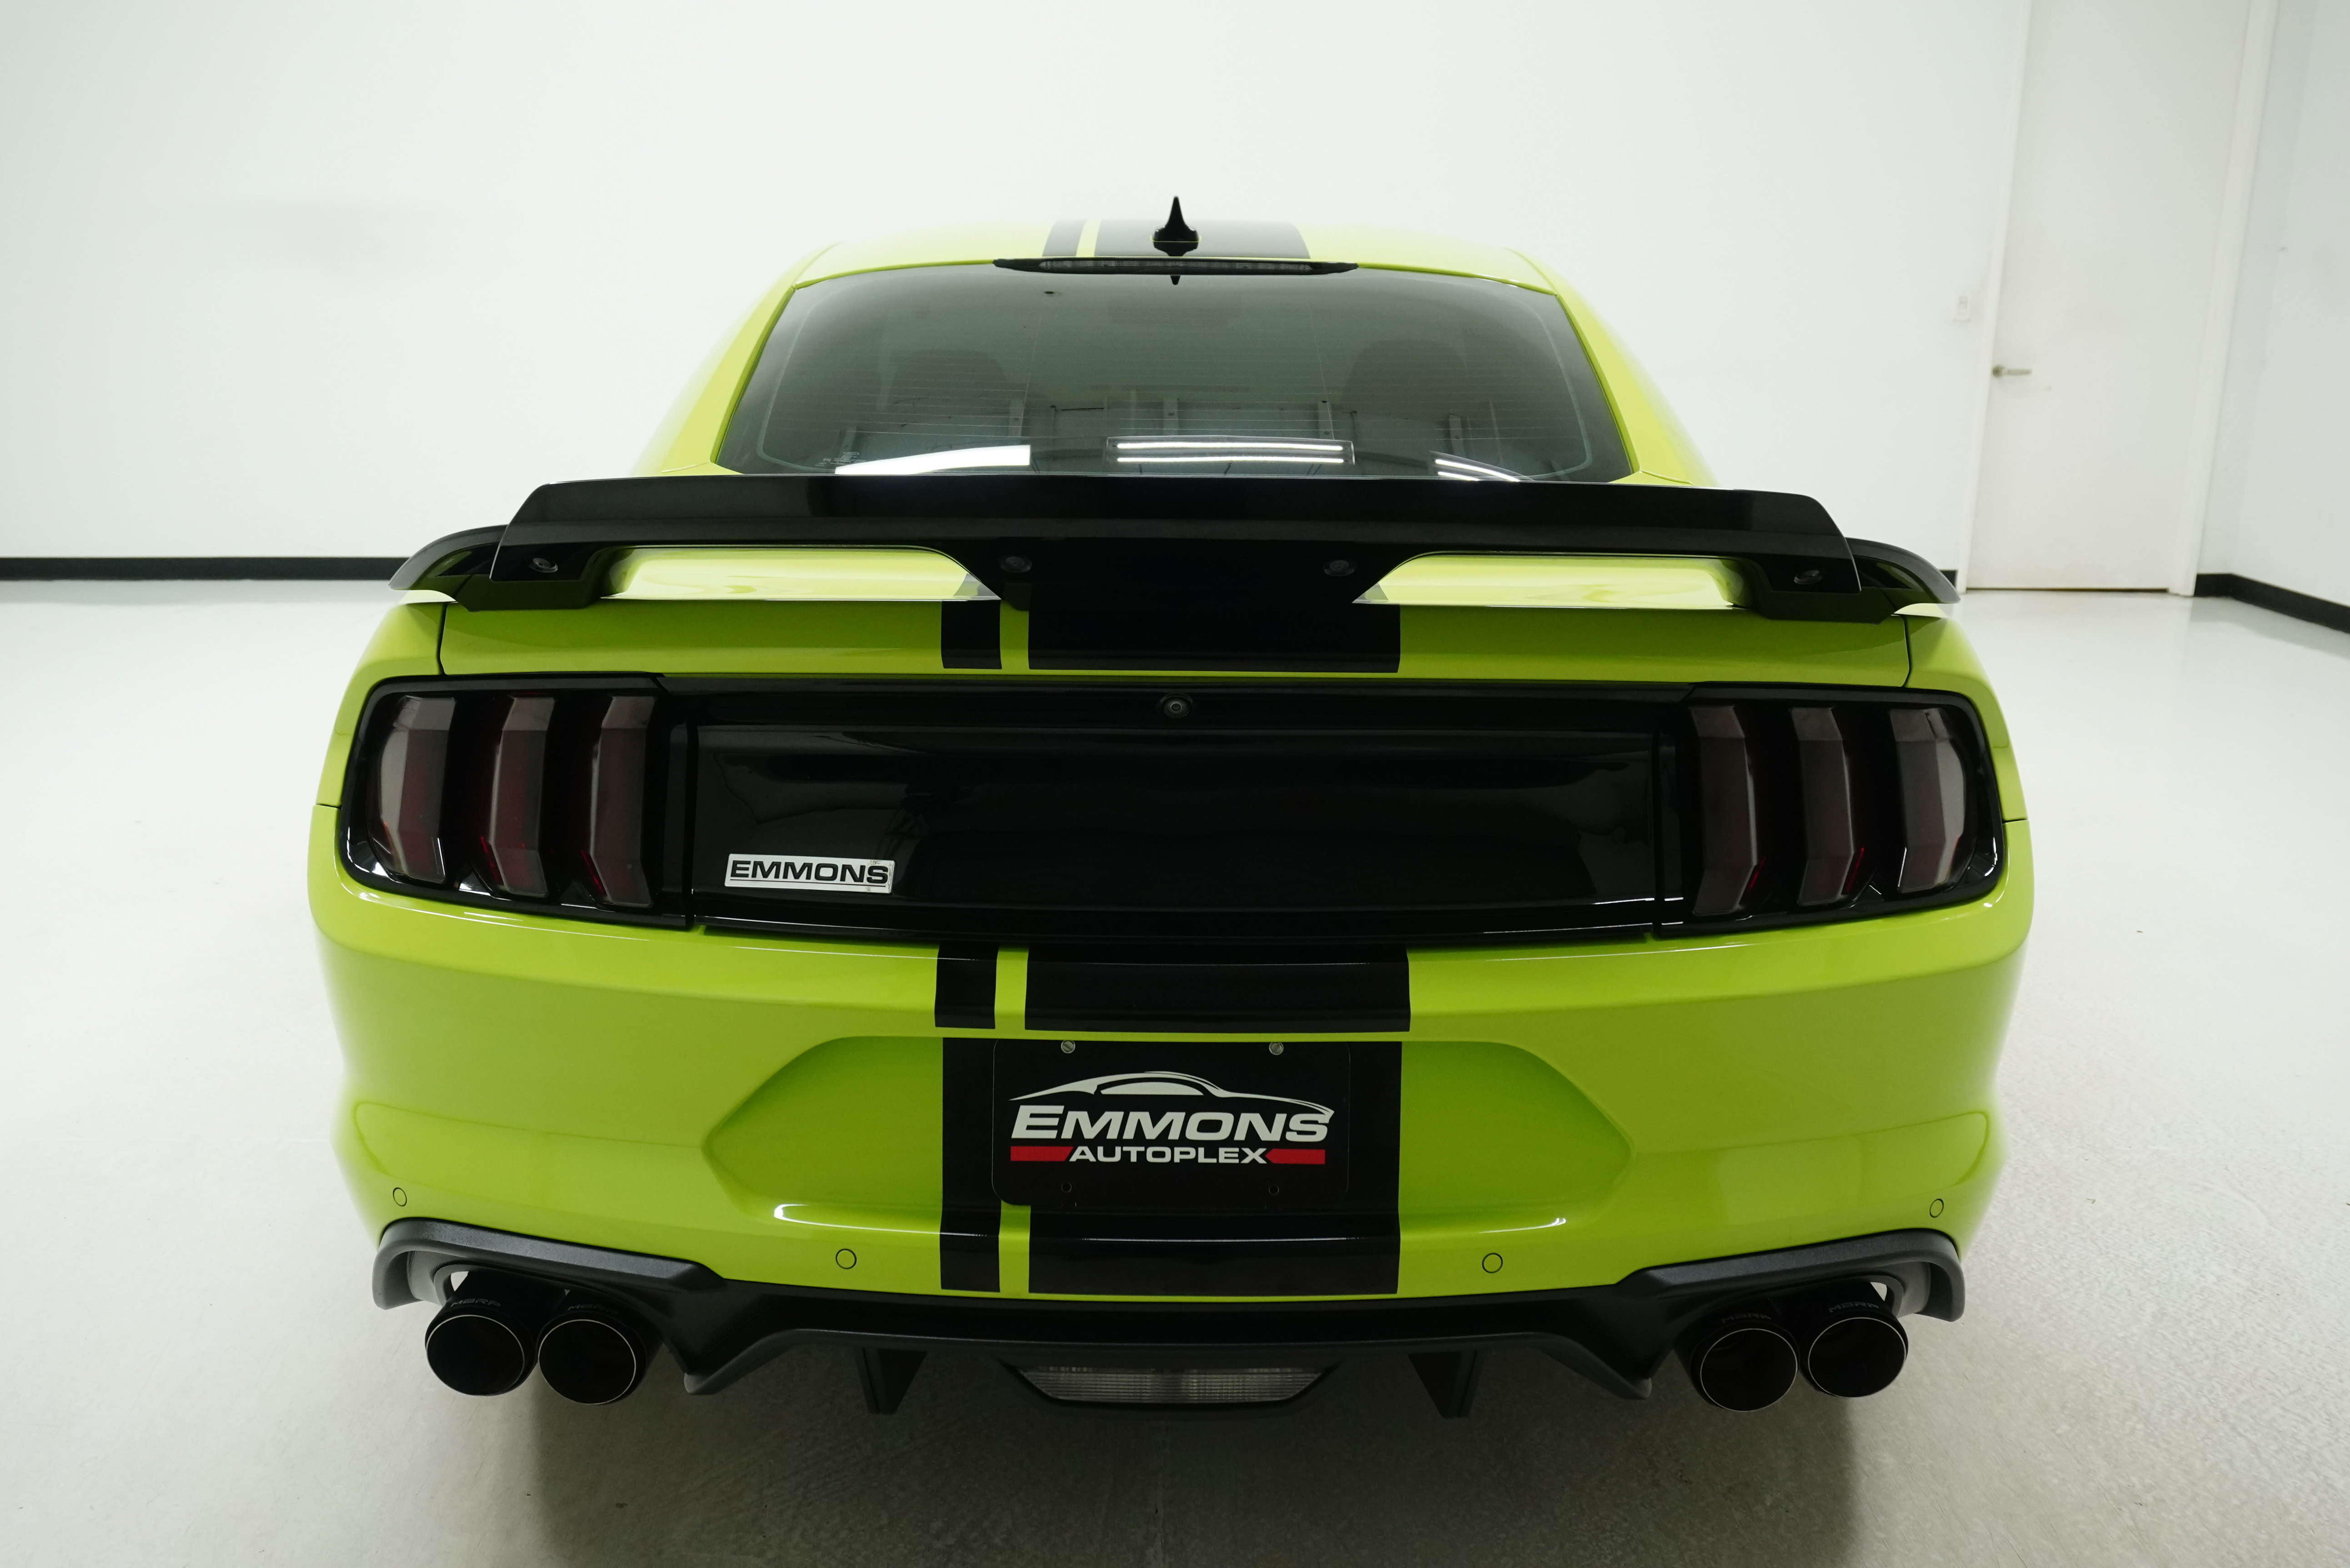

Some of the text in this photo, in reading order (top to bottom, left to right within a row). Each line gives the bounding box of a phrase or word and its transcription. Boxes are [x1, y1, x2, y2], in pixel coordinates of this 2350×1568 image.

[730, 860, 889, 884] EMMONS
[1010, 1105, 1330, 1143] EMMONS
[1069, 1146, 1268, 1164] AUTOPLEX
